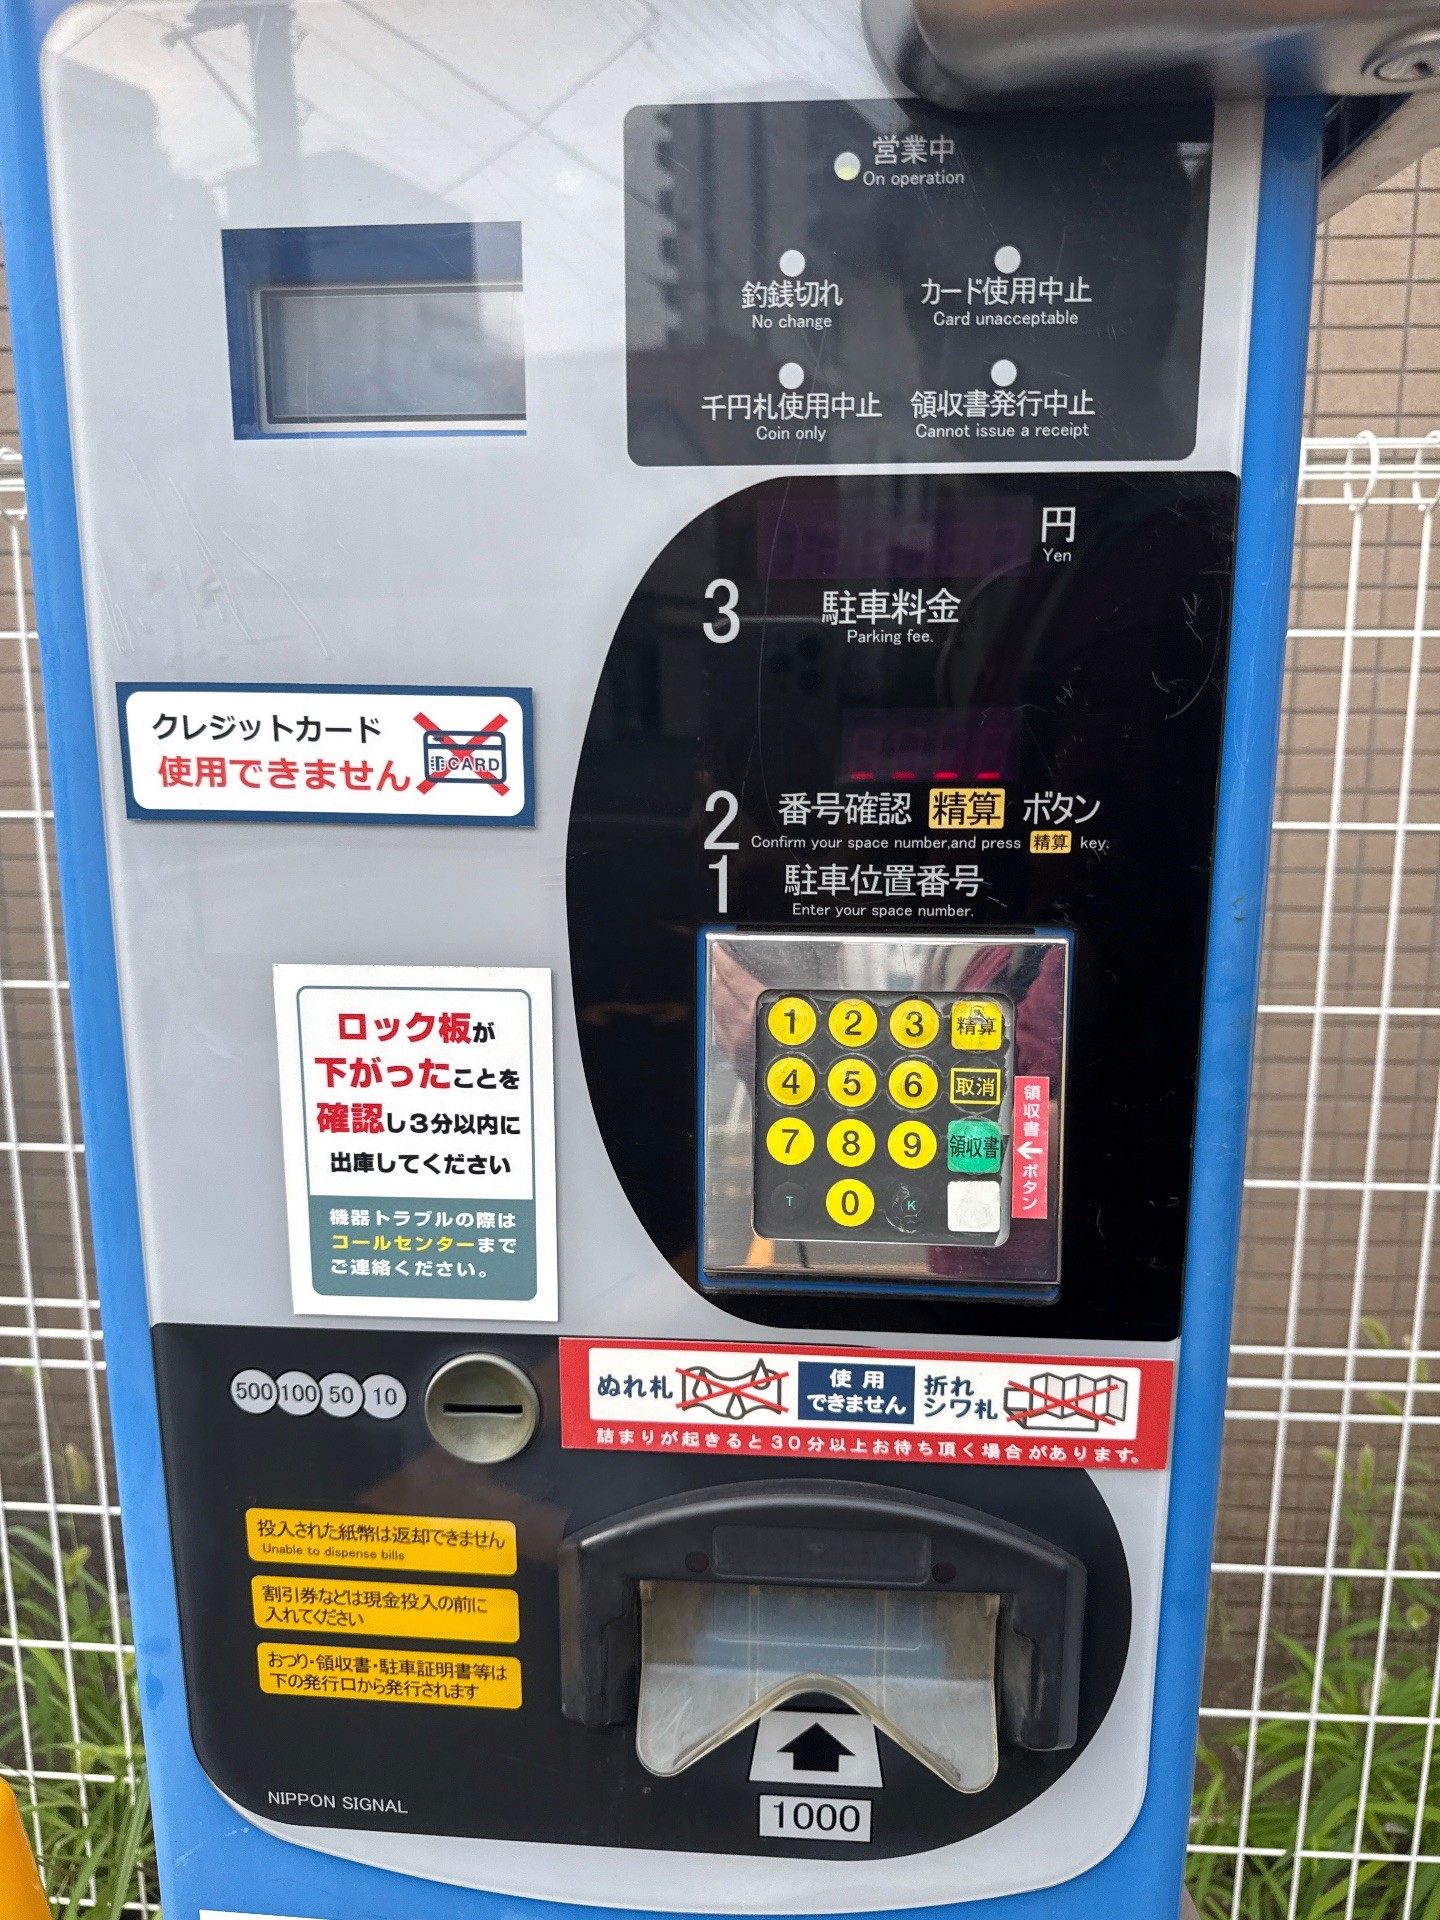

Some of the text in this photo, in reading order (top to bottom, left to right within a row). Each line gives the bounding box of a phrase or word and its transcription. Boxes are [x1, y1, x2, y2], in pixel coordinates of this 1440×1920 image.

[873, 136, 954, 165] 営業中
[863, 170, 964, 186] On operation
[742, 280, 843, 309] 釣銭切れ
[921, 276, 1091, 305] カード使用中止
[752, 313, 832, 331] No change
[934, 310, 1078, 327] Card unacceptable
[701, 392, 882, 421] 千円札使用中止
[911, 389, 1095, 418] 領収書発行中止
[756, 426, 826, 442] Coin only
[915, 423, 1089, 439] Cannot issue a receipt
[1041, 507, 1076, 543] 円
[1043, 549, 1072, 562] Yen
[703, 578, 961, 644] 3 駐車料金
[847, 629, 933, 645] Parking fee.
[152, 713, 381, 743] クレジットカード
[157, 756, 410, 792] 使用できません
[447, 757, 500, 772] CARD
[703, 790, 1101, 850] 2 番号確認 精算 ボタン
[751, 835, 806, 850] Confirm
[811, 838, 843, 851] your
[848, 838, 889, 852] space
[981, 838, 1021, 852] press
[1033, 833, 1069, 851] 精算
[1080, 836, 1109, 853] key.
[708, 855, 983, 913] 1 駐車位置番号
[792, 903, 973, 920] Enter your space number.
[338, 1012, 495, 1044] ロック板が
[783, 1009, 797, 1035] 1
[844, 1010, 862, 1035] 2
[905, 1011, 923, 1037] 3
[315, 1057, 520, 1090] 下がったことを
[781, 1070, 800, 1094] 4
[843, 1071, 861, 1096] 5
[904, 1072, 923, 1097] 6
[955, 1077, 996, 1096] 取消
[781, 1129, 799, 1154] 7
[842, 1130, 860, 1156] 8
[903, 1132, 921, 1158] 9
[949, 1135, 1000, 1159] 領収書
[1022, 1085, 1041, 1210] 領収書 ボタン
[330, 1152, 511, 1175] 出庫してください
[786, 1197, 794, 1206] T
[841, 1191, 859, 1215] 0
[908, 1201, 916, 1210] K
[329, 1208, 516, 1229] 機器トラブルの際は
[332, 1235, 517, 1254] コールセンターまで
[330, 1259, 487, 1278] ご連絡ください。
[236, 1383, 272, 1400] 500
[280, 1384, 316, 1401] 100
[329, 1386, 354, 1403] 50
[373, 1388, 397, 1405] 10
[597, 1374, 674, 1399] ぬれ札
[923, 1374, 974, 1397] 折れ
[806, 1393, 907, 1416] できません
[923, 1396, 998, 1420] シワ札
[257, 1519, 505, 1549] 投入された紙幣は返却できません
[262, 1543, 405, 1561] Unable to dispense bills
[262, 1585, 488, 1614] 割引券などは現金投入の前に
[265, 1606, 364, 1628] 入れてください
[270, 1672, 480, 1700] 下の発行口から発行されます
[268, 1791, 409, 1814] NIPPON SIGNAL
[773, 1802, 860, 1832] 1000
